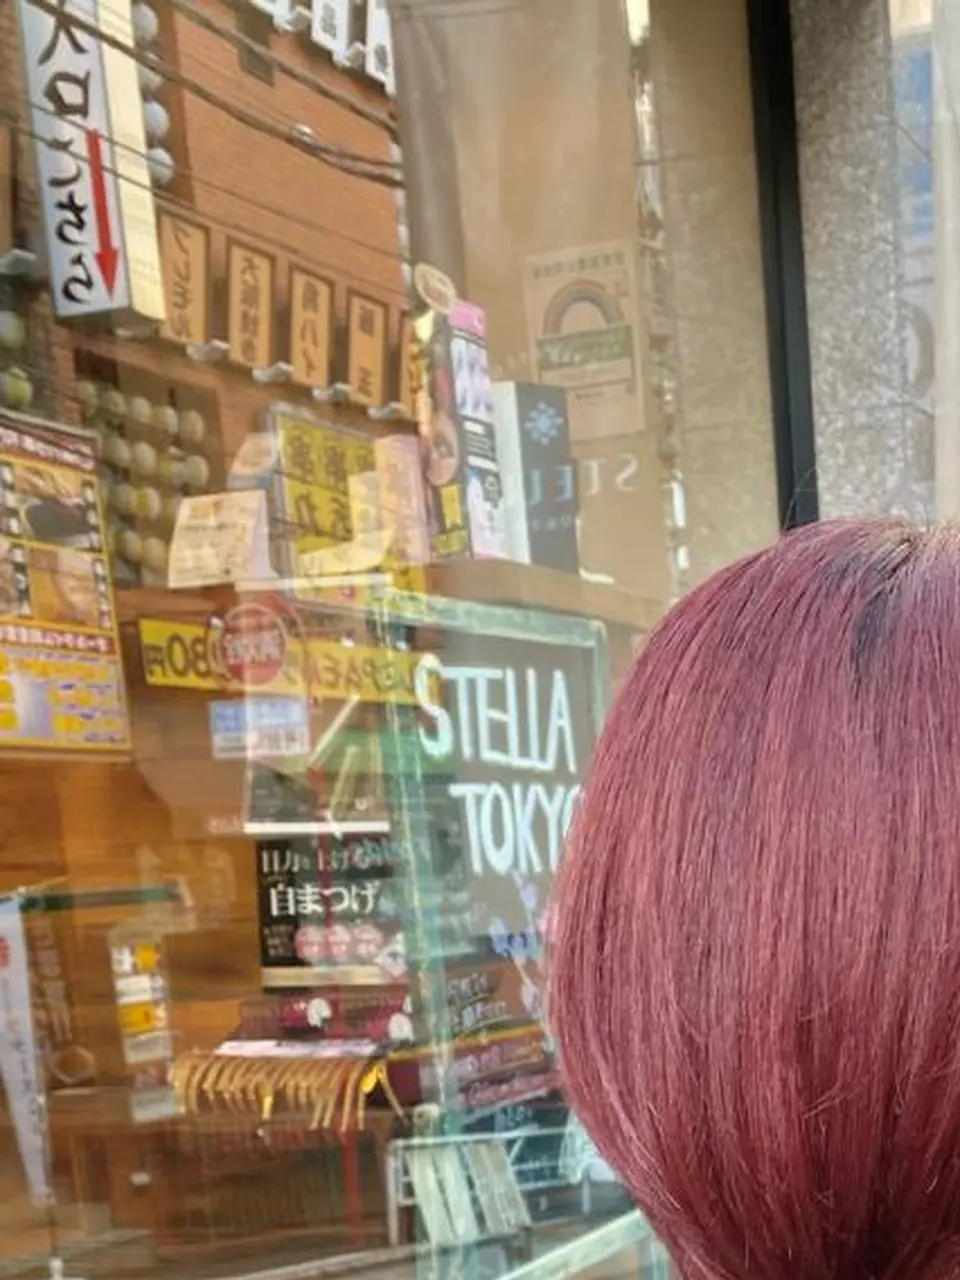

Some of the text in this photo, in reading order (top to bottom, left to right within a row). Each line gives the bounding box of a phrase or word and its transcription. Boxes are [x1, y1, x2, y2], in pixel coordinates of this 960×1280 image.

[414, 652, 578, 773] STELLA
[269, 880, 380, 917] 自まつげ
